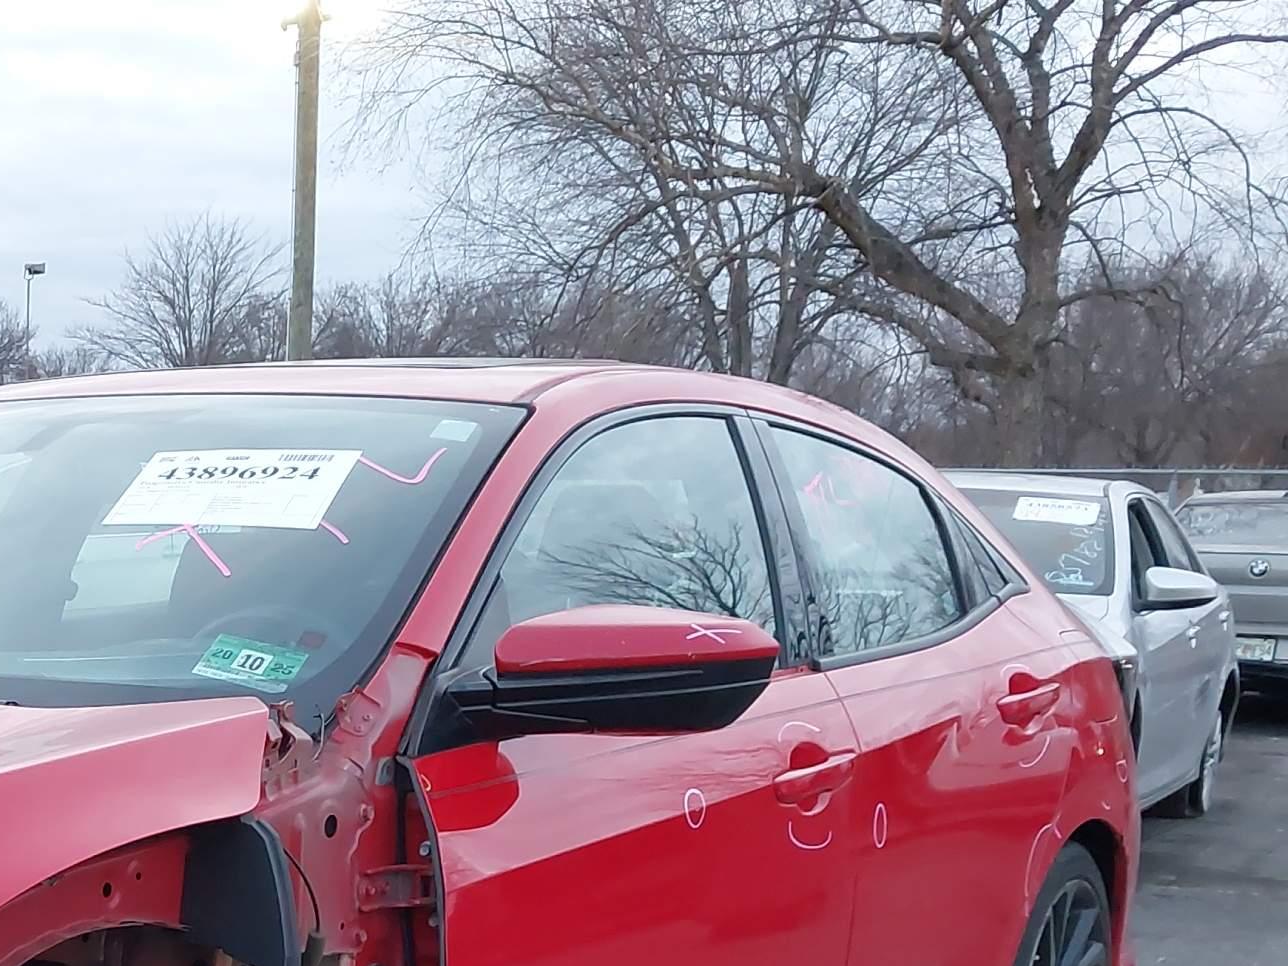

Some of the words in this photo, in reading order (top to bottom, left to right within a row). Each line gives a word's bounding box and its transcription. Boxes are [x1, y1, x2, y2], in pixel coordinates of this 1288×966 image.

[158, 466, 321, 480] 43896924
[212, 648, 233, 660] 20
[237, 654, 265, 671] 10
[271, 663, 295, 675] 25
